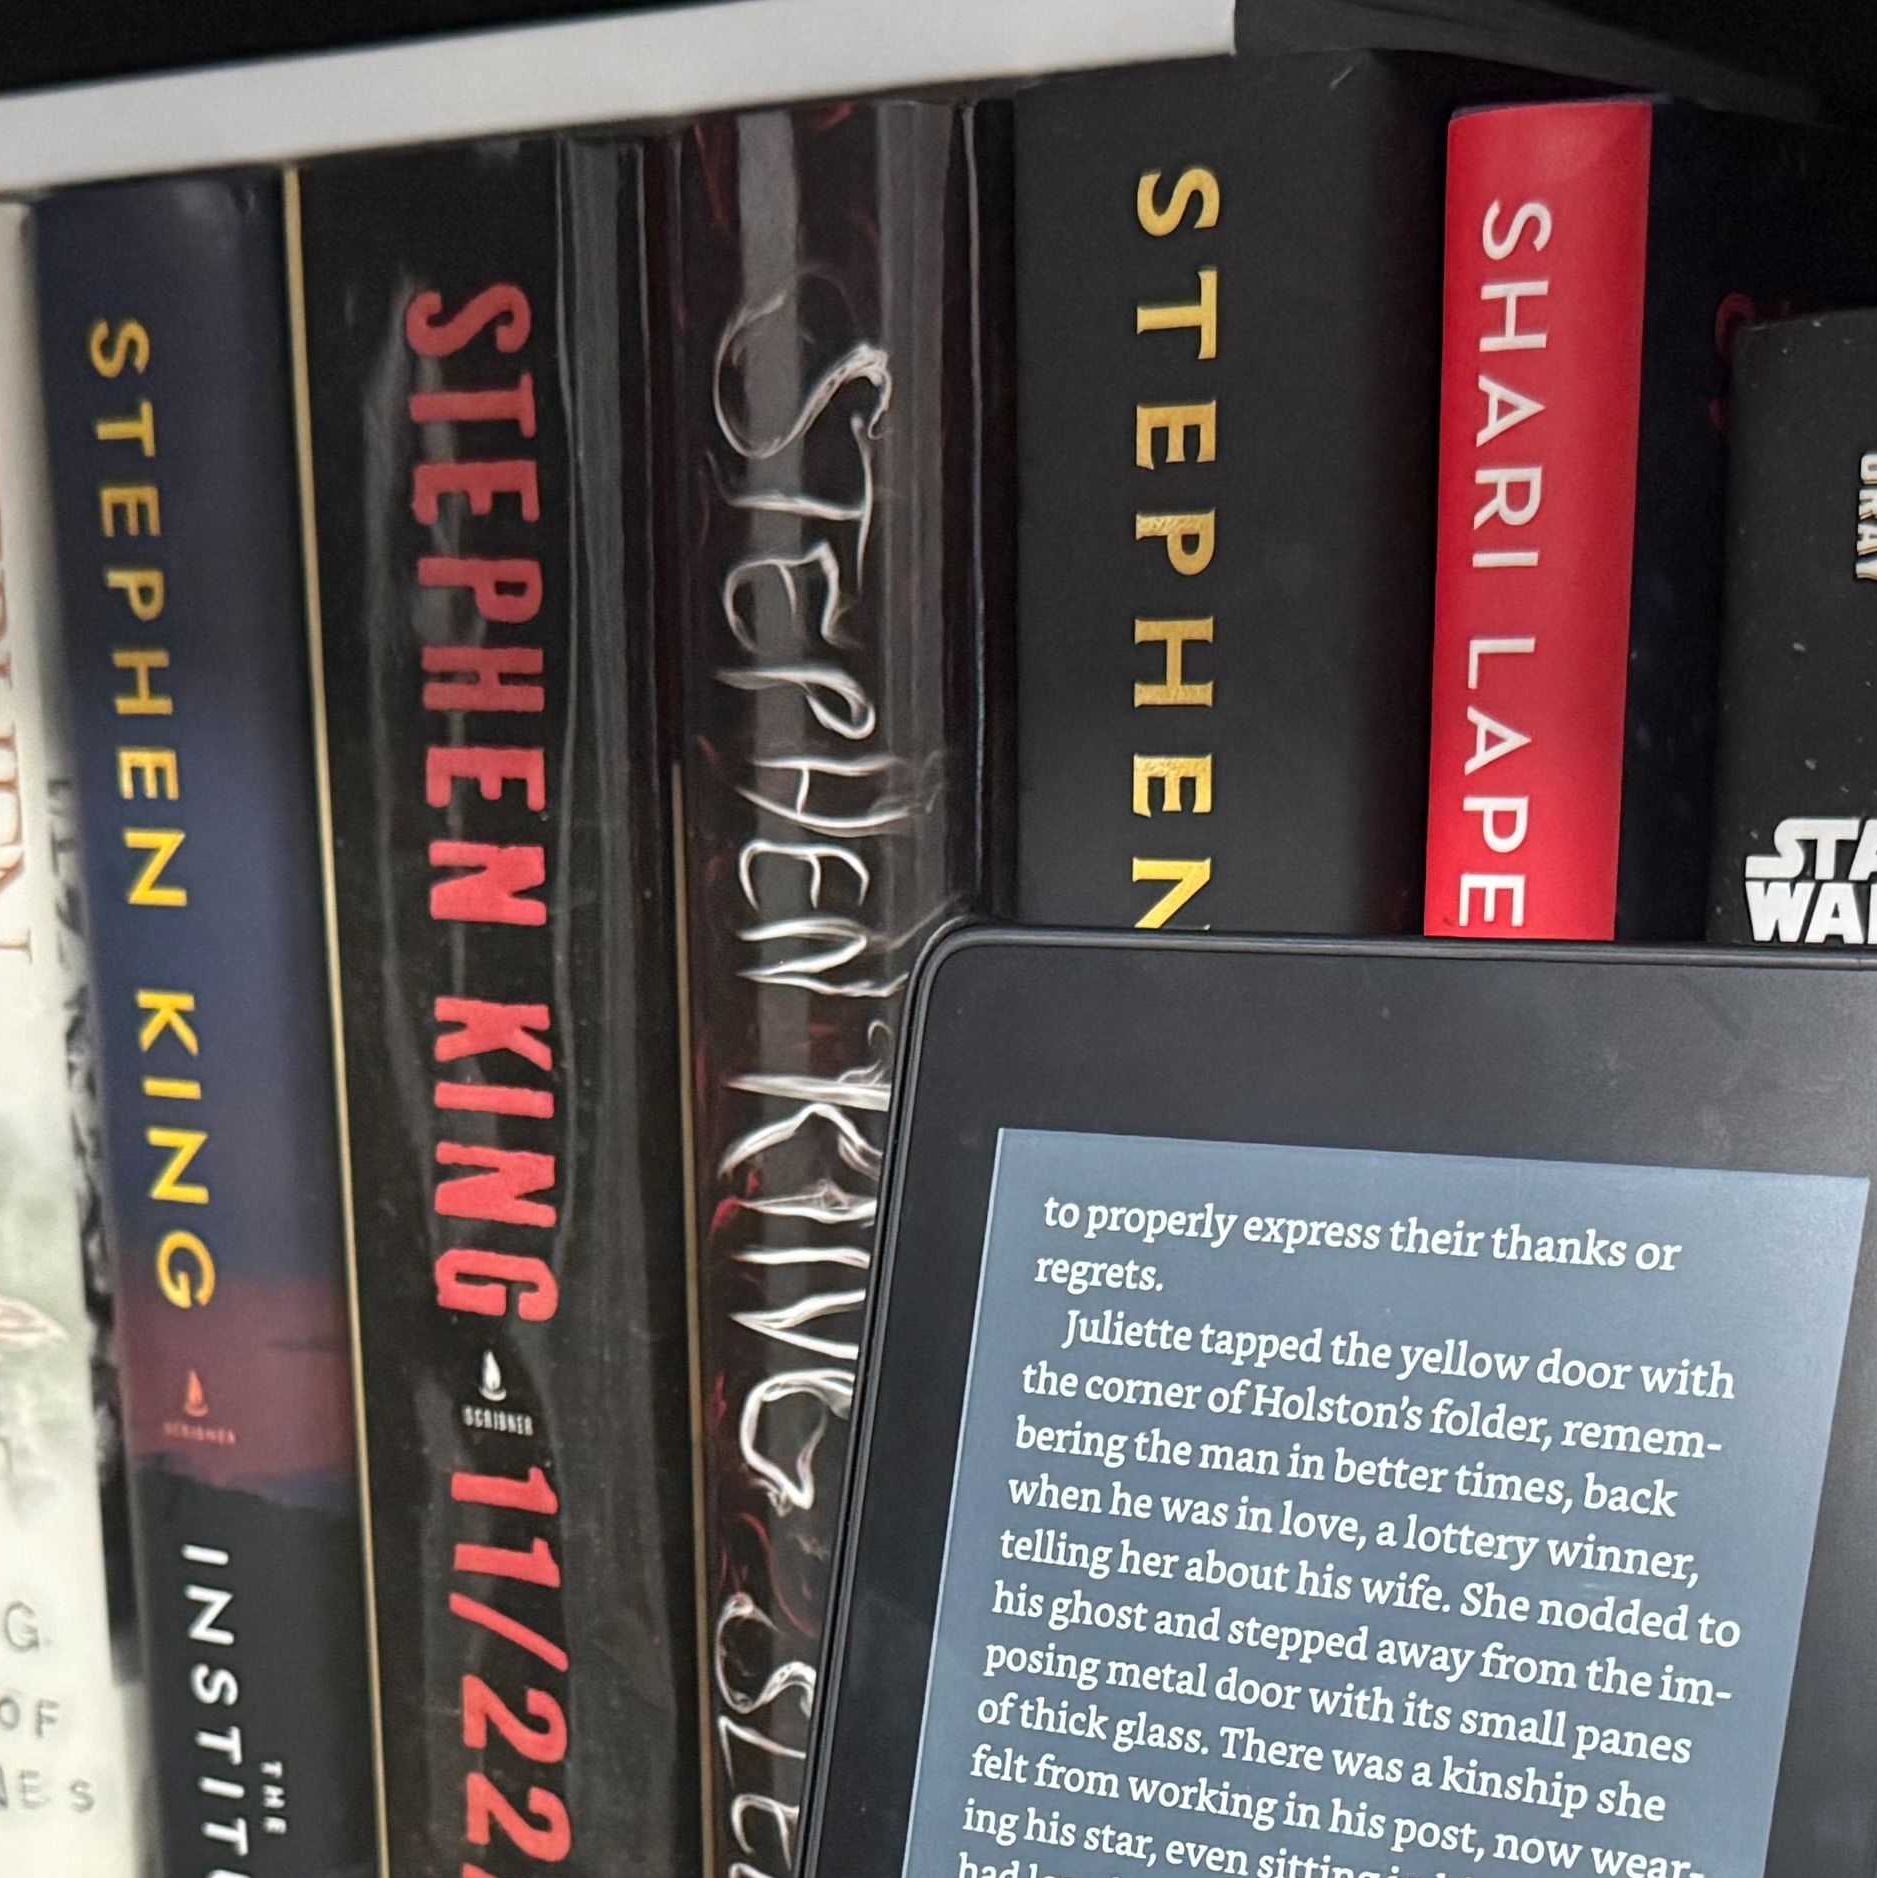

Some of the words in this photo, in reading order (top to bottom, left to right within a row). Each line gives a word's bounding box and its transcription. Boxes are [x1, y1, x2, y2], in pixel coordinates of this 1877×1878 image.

[1472, 200, 1552, 570] SHARI
[89, 318, 188, 906] STEPHEN
[406, 283, 546, 926] STEPHEN
[712, 295, 922, 998] STEPHEN
[136, 989, 215, 1310] KING
[434, 998, 560, 1321] KING
[1043, 1196, 1081, 1230] to
[1083, 1202, 1239, 1249] properly
[1242, 1215, 1382, 1255] express
[1388, 1215, 1486, 1258] their
[1489, 1222, 1628, 1268] thanks
[1634, 1242, 1684, 1272] or
[719, 1018, 892, 1512] KING
[1033, 1256, 1165, 1296] regrets.
[1060, 1308, 1194, 1353] Juliette
[1199, 1321, 1324, 1369] tapped
[1329, 1329, 1393, 1370] the
[1395, 1337, 1531, 1382] yellow
[1535, 1346, 1633, 1391] door
[1639, 1358, 1735, 1401] with
[463, 1404, 534, 1437] SCRIBNER
[1015, 1413, 1130, 1470] bering
[1133, 1427, 1193, 1467] the
[1197, 1442, 1281, 1477] man
[1285, 1441, 1326, 1482] in
[1333, 1445, 1450, 1494] better
[1453, 1460, 1574, 1515] times,
[1582, 1470, 1679, 1518] back
[1021, 1358, 1080, 1398] the
[1083, 1374, 1203, 1411] corner
[1206, 1378, 1253, 1416] of
[1428, 1396, 1553, 1453] folder,
[1559, 1419, 1723, 1460] remem-
[259, 1760, 286, 1834] THE
